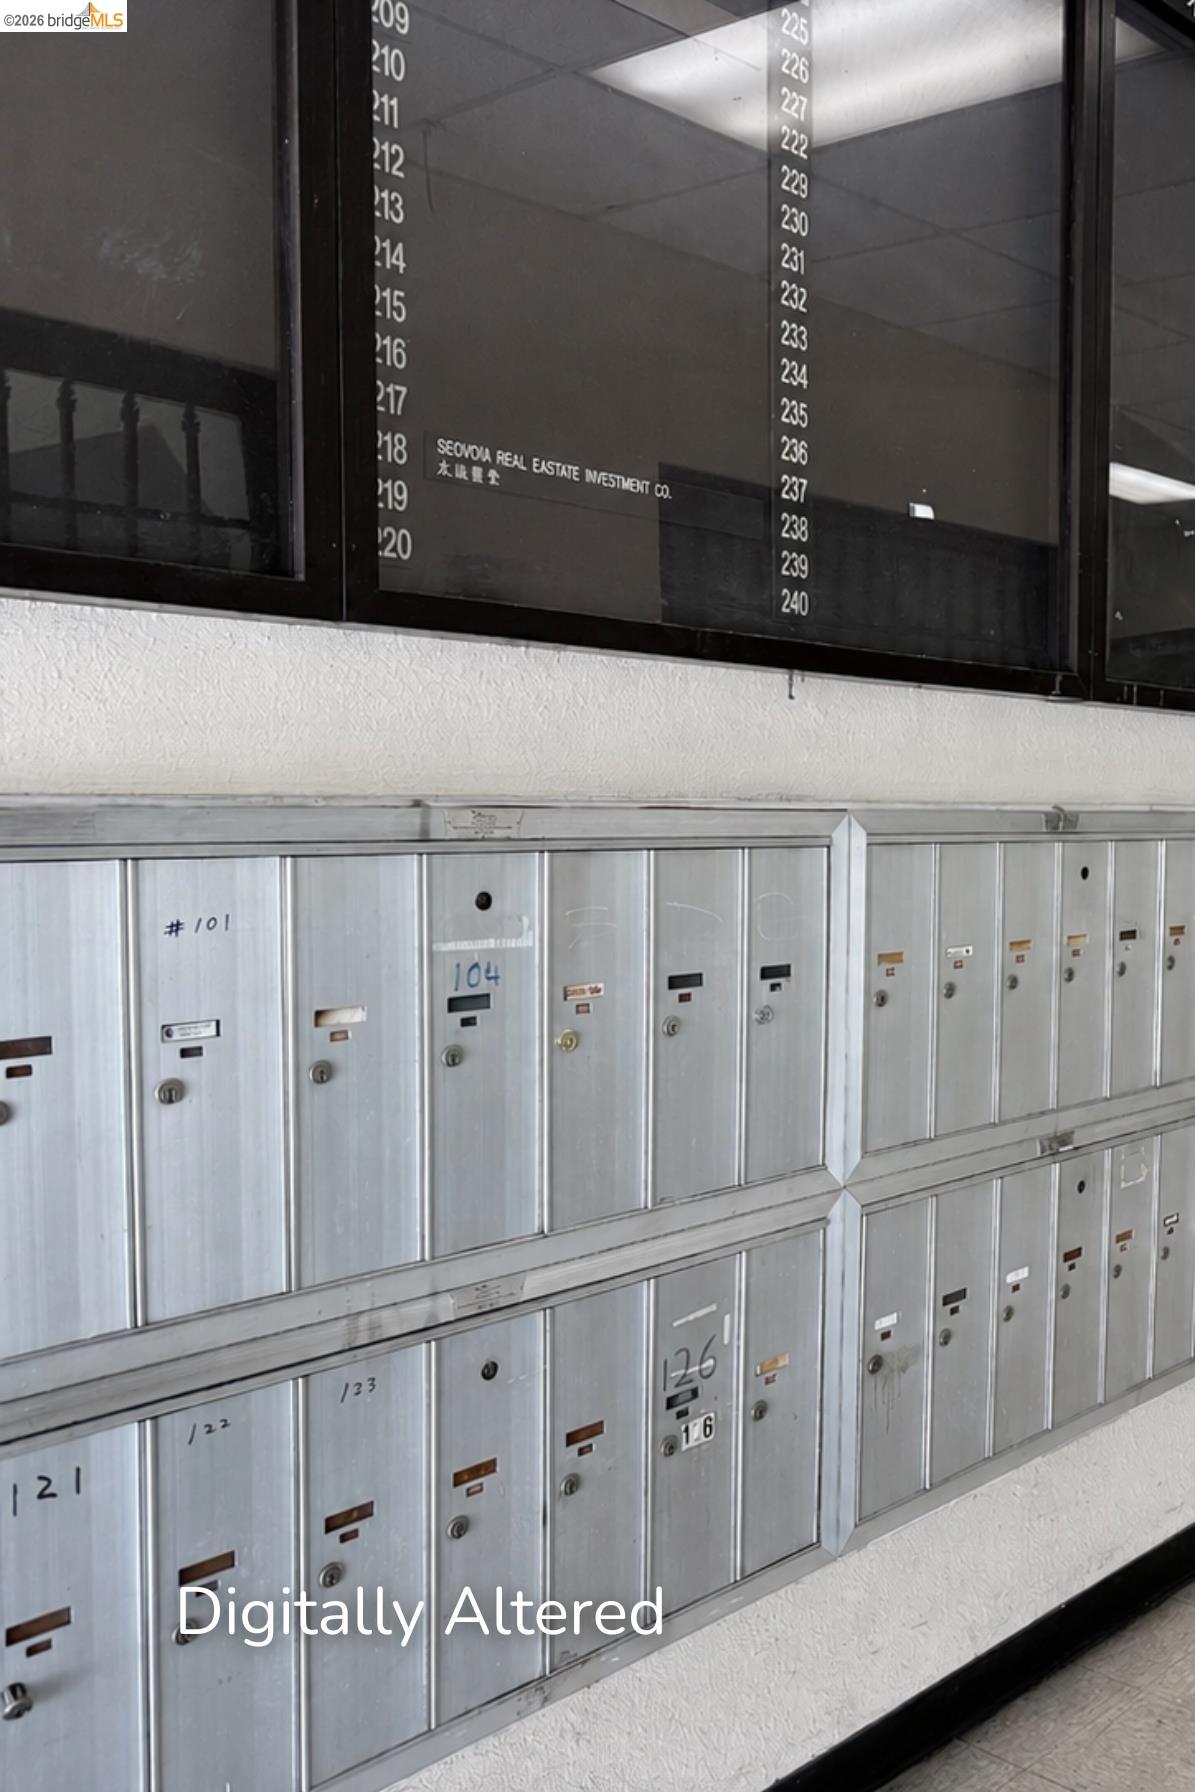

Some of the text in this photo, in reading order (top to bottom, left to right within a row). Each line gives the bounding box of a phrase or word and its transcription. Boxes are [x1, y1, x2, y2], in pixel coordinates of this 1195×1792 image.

[780, 8, 809, 46] 225
[780, 48, 809, 83] 226
[780, 87, 808, 121] 227
[780, 203, 809, 237] 230
[780, 242, 805, 275] 231
[780, 279, 808, 313] 232
[780, 319, 808, 352] 233
[780, 357, 809, 389] 234
[780, 396, 808, 429] 235
[780, 434, 808, 466] 236
[496, 450, 528, 471] REAL
[532, 458, 580, 482] EASTATE
[655, 483, 673, 500] CO.
[780, 474, 808, 503] 237
[377, 526, 412, 560] 20
[780, 512, 809, 543] 238
[780, 549, 809, 580] 239
[781, 587, 809, 617] 240
[452, 961, 501, 992] 104
[662, 1333, 717, 1392] 126
[187, 1417, 232, 1446] 122
[682, 1415, 713, 1445] 16
[11, 1466, 82, 1517] 121
